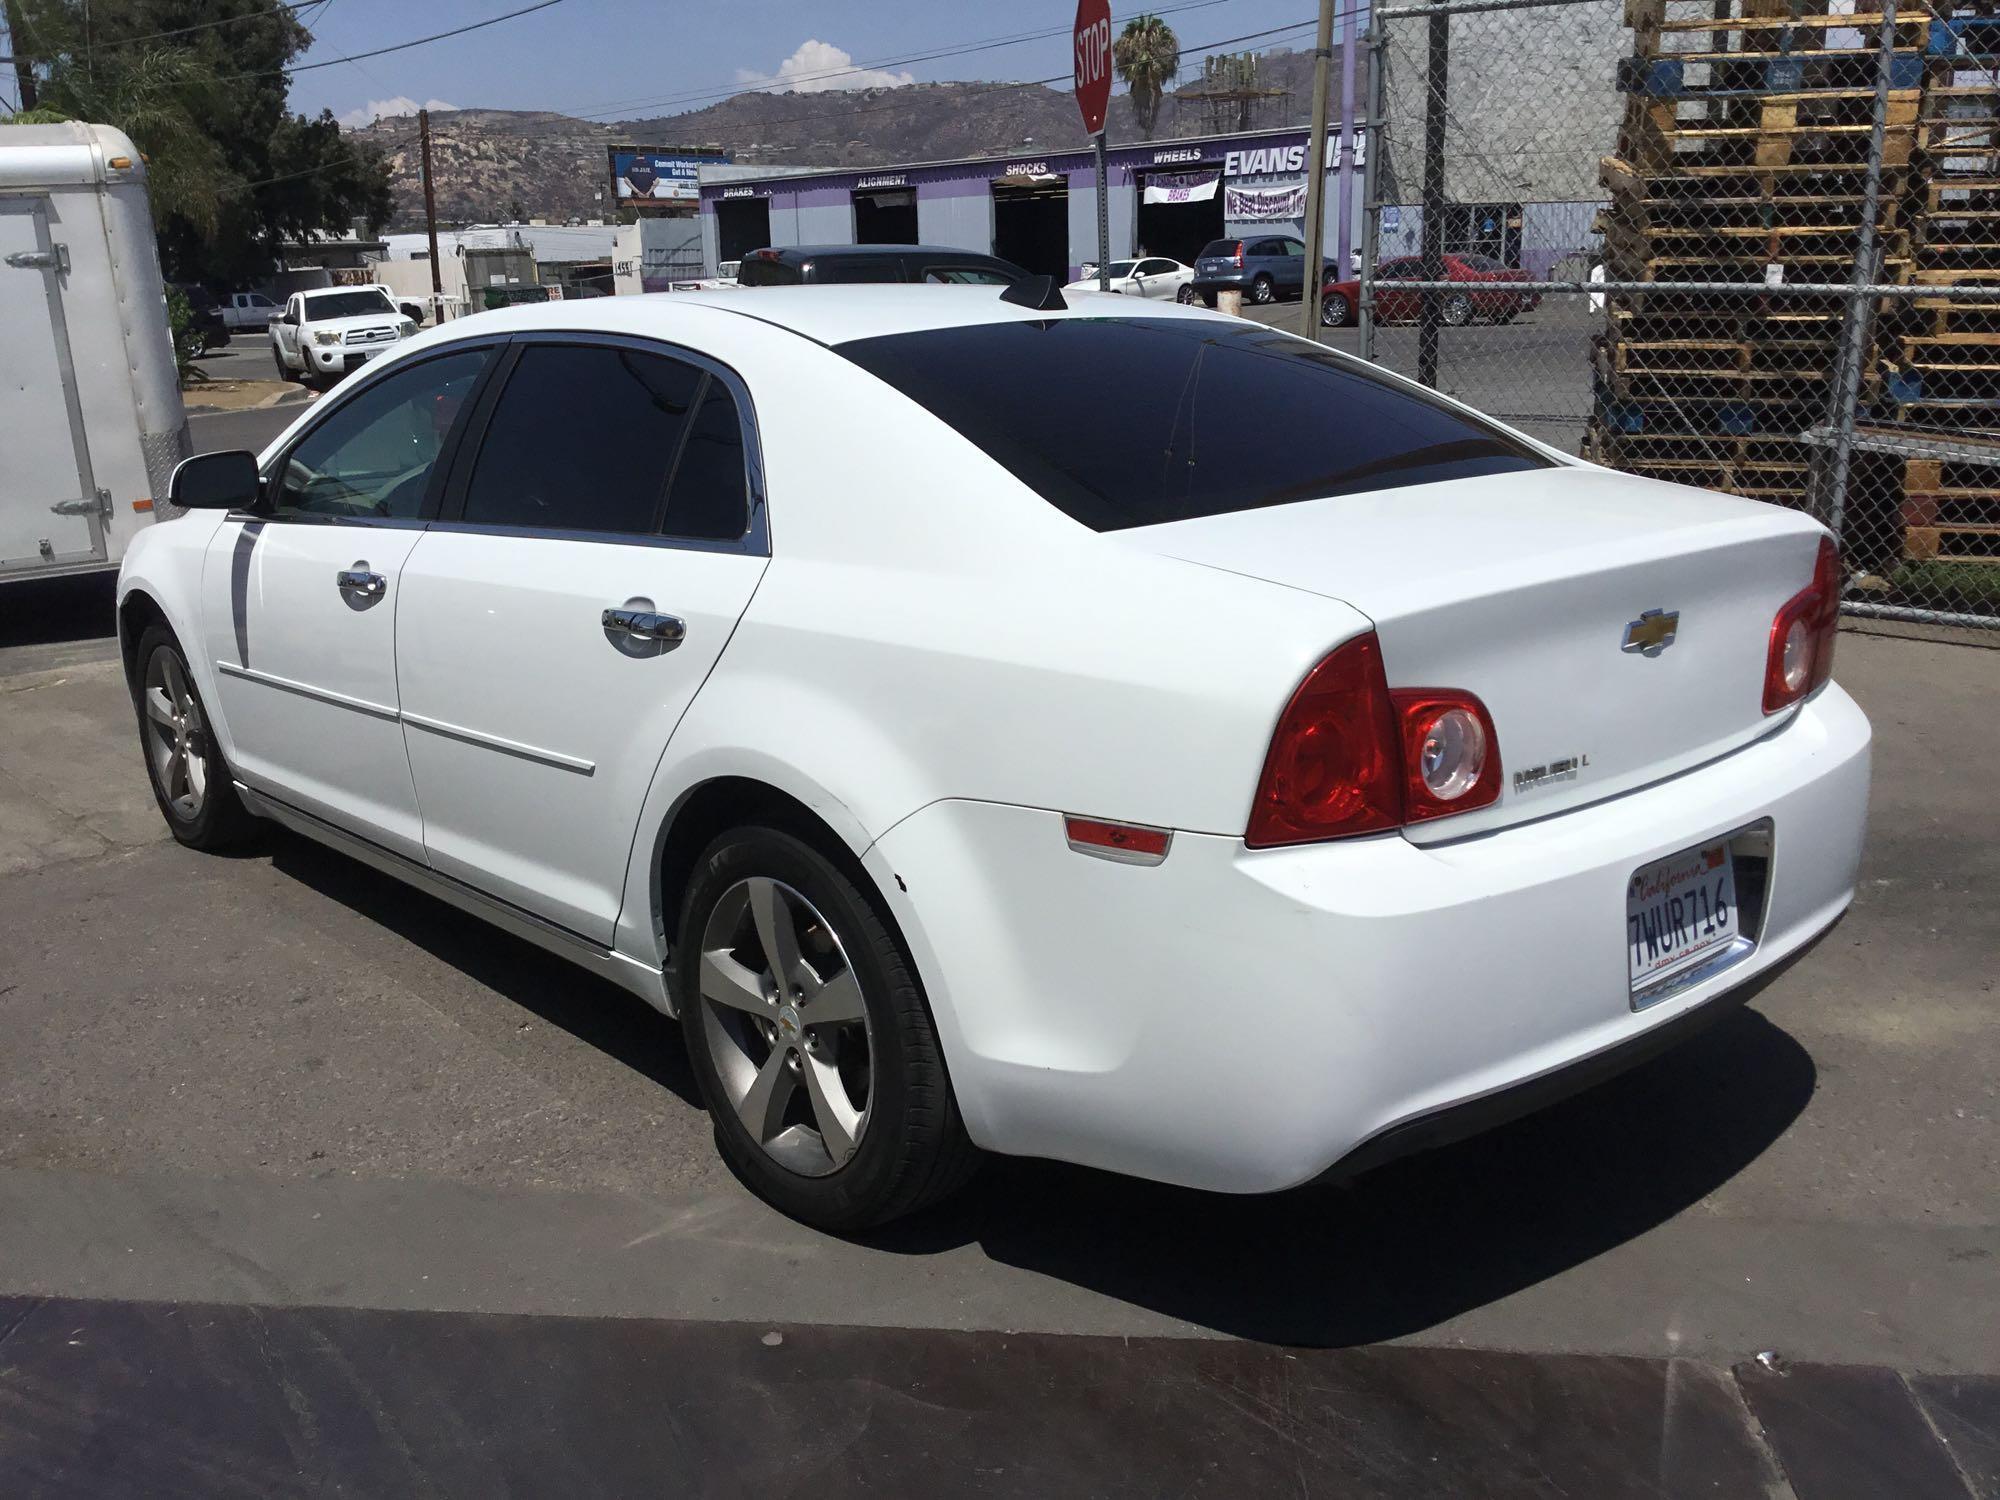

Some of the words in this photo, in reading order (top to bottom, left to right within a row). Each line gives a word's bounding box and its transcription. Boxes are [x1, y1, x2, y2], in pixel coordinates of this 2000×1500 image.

[1076, 17, 1109, 89] STOP
[654, 159, 675, 168] Commit
[1153, 148, 1202, 164] WHEELS
[1224, 145, 1305, 176] EVANS
[1006, 162, 1049, 176] SHOCKS
[857, 174, 907, 189] ALIGNMENT
[723, 186, 754, 198] BRAKES
[1167, 188, 1190, 202] BRAKES
[1226, 190, 1237, 214] We
[1639, 863, 1709, 901] California
[1628, 877, 1728, 966] 7WUR716
